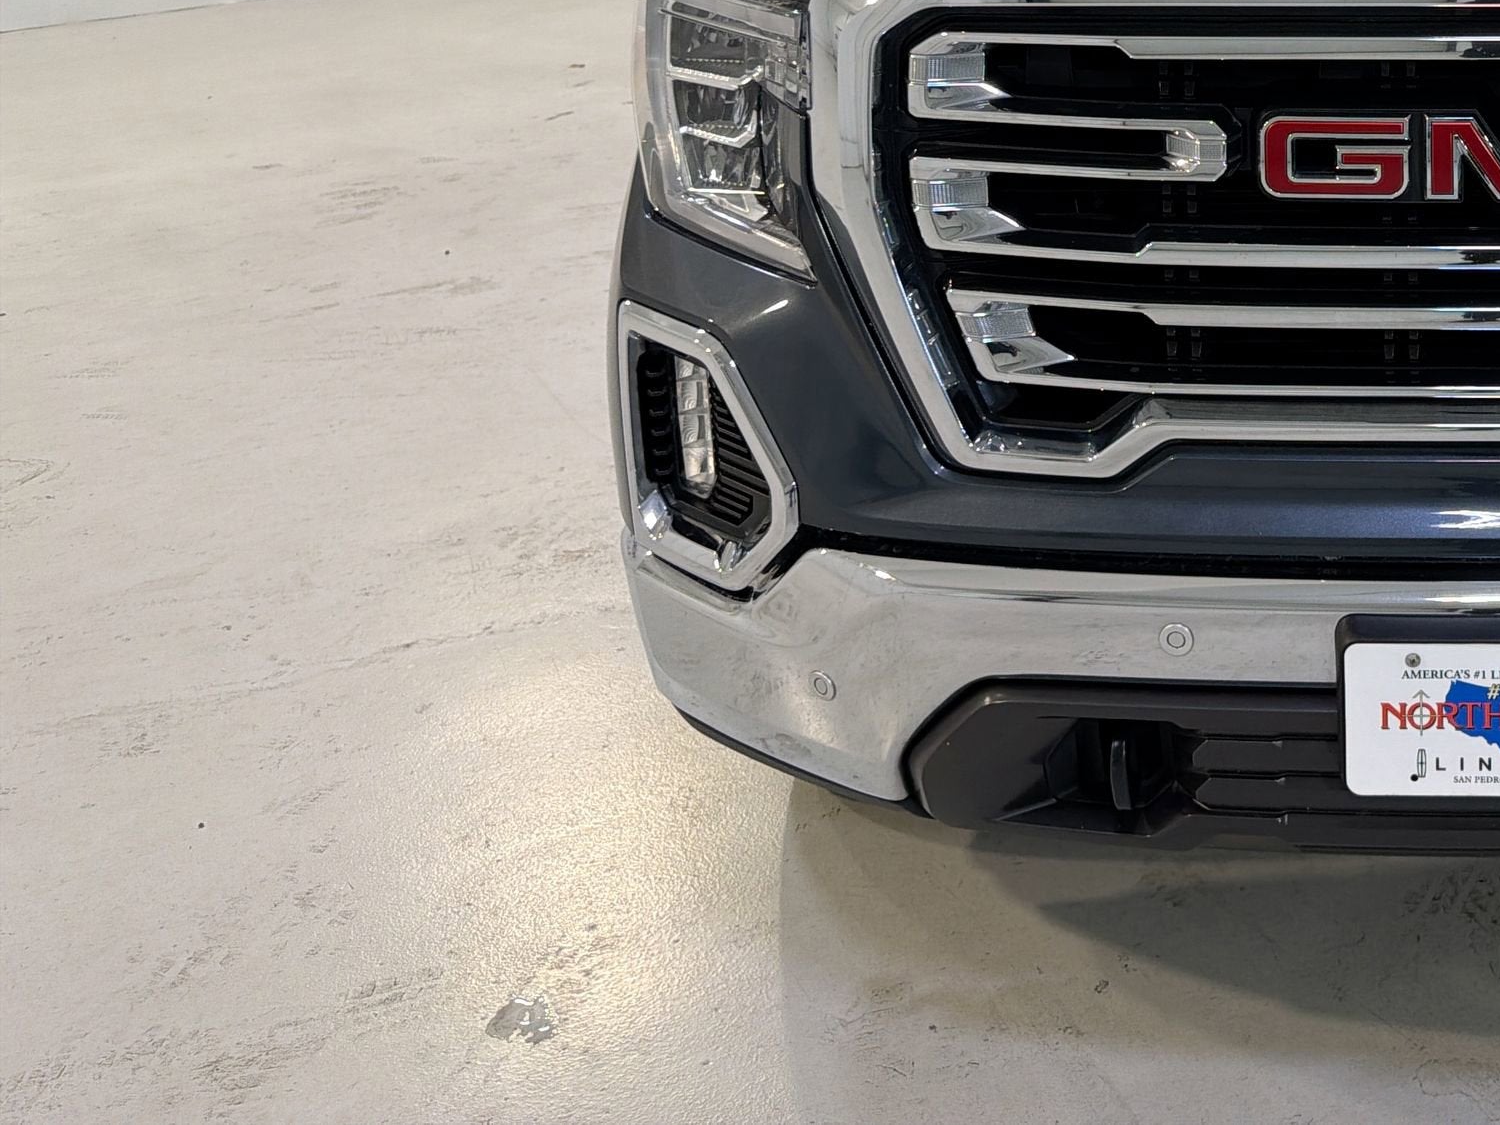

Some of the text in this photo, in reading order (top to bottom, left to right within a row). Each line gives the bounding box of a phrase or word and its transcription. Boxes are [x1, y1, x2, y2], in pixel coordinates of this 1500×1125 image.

[1401, 669, 1471, 680] AMERICA'S
[1473, 670, 1487, 680] #1
[1453, 775, 1472, 784] SAN
